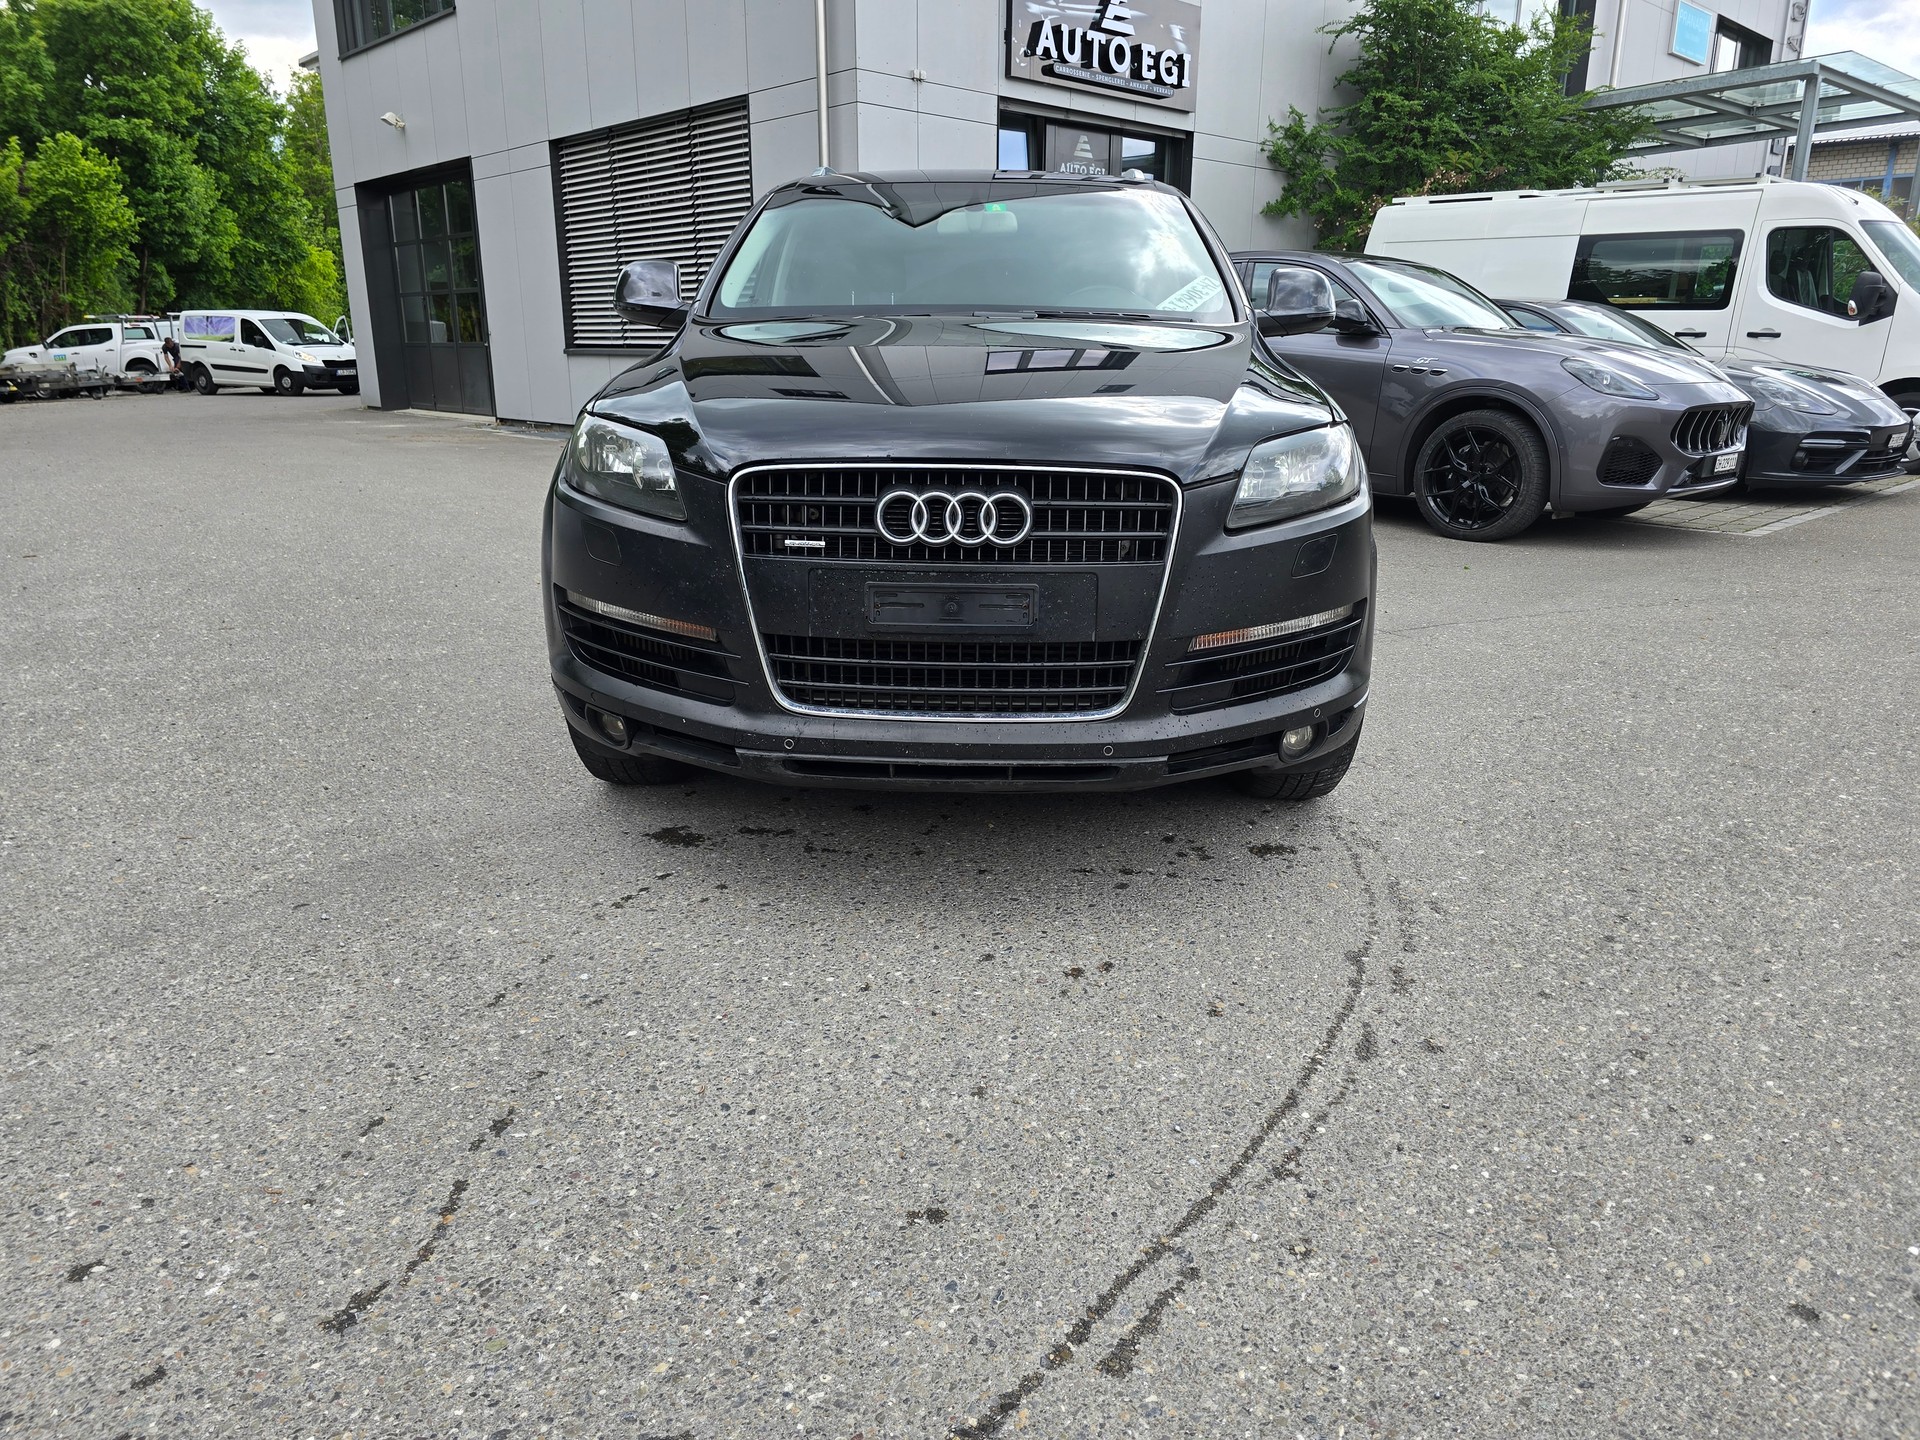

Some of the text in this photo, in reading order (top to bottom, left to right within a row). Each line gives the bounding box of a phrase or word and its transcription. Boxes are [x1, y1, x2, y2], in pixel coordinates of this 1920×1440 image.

[1036, 18, 1192, 88] AUTO EGI
[1055, 65, 1174, 96] CARROSSERIE SPENGLEREI ANKAUF VERKAUF
